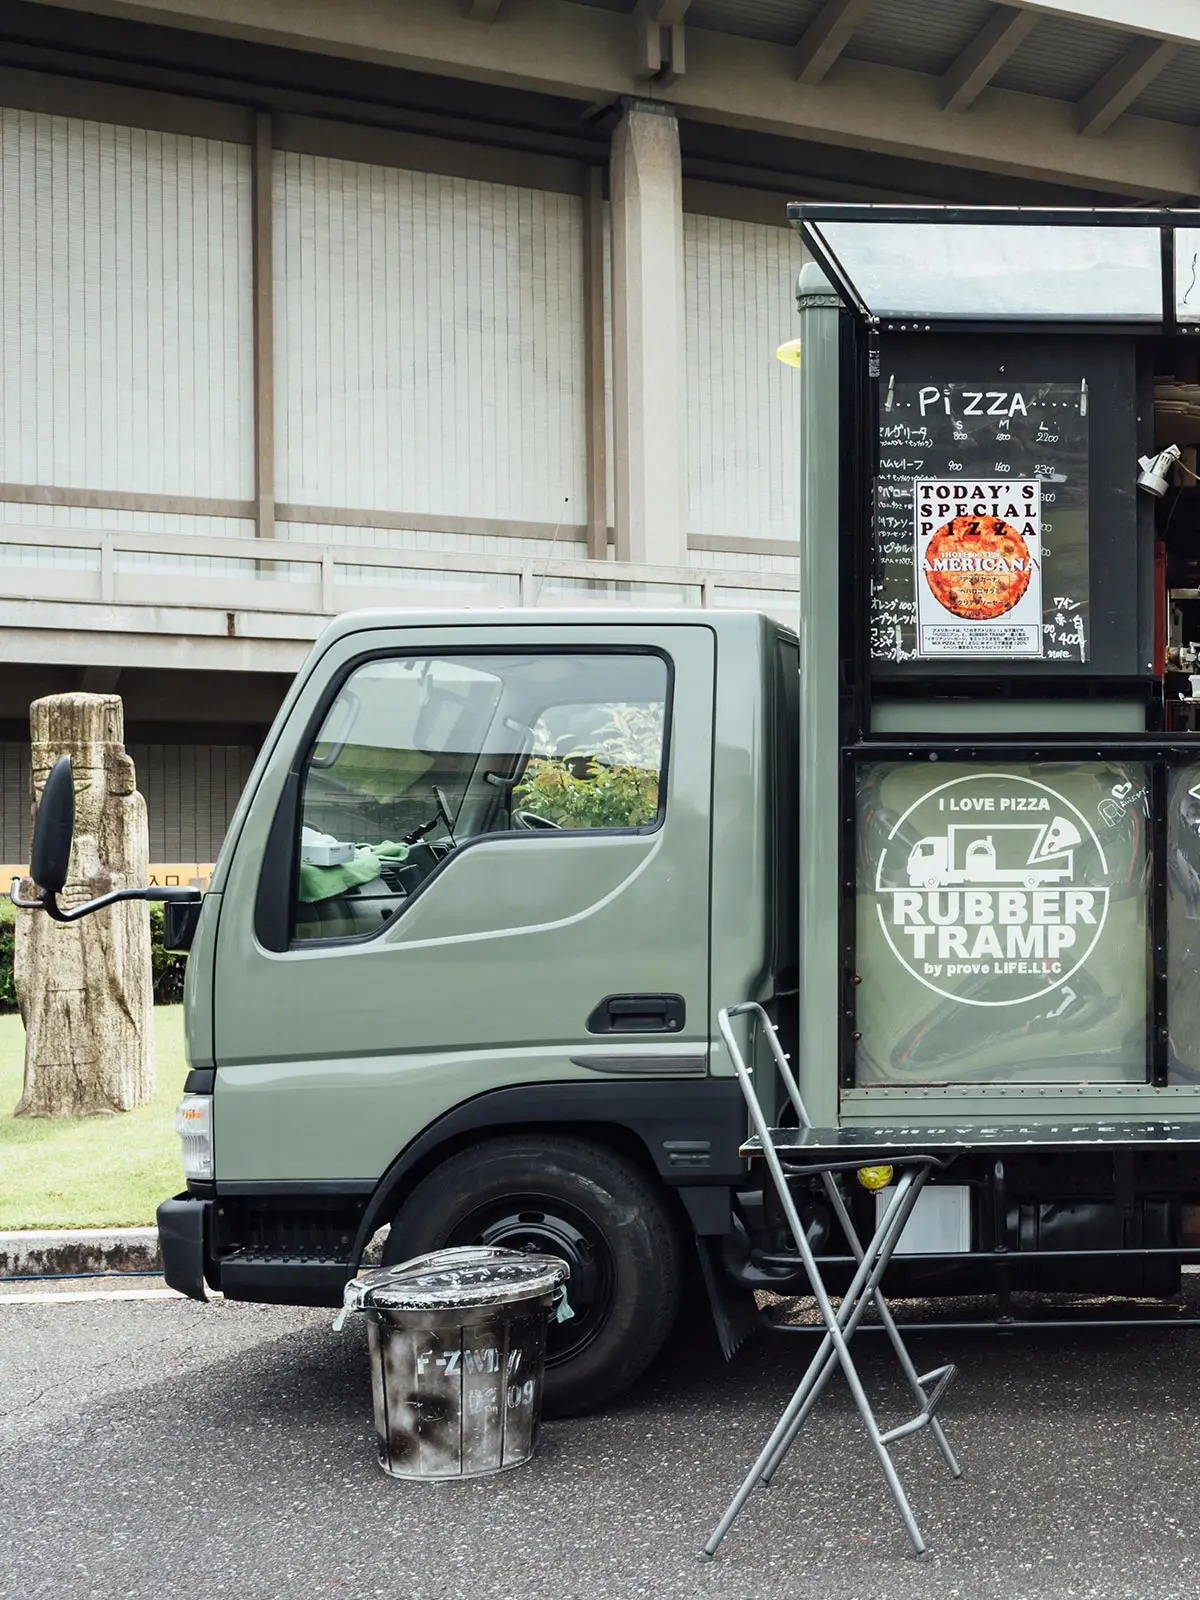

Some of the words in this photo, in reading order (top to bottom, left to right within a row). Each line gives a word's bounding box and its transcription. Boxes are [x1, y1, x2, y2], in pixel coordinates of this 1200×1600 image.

[956, 420, 964, 430] S
[998, 419, 1010, 430] M
[953, 432, 968, 441] 800
[948, 460, 963, 471] 900
[920, 503, 1036, 517] SPECIAL
[921, 522, 1036, 536] PIZZA
[922, 558, 1040, 572] AMERICANA
[939, 798, 944, 811] I
[950, 798, 994, 811] LOVE
[1000, 798, 1051, 811] PIZZA
[893, 891, 1097, 925] RUBBER
[904, 925, 1076, 959] TRAMP
[924, 962, 943, 977] by
[947, 963, 990, 977] prove
